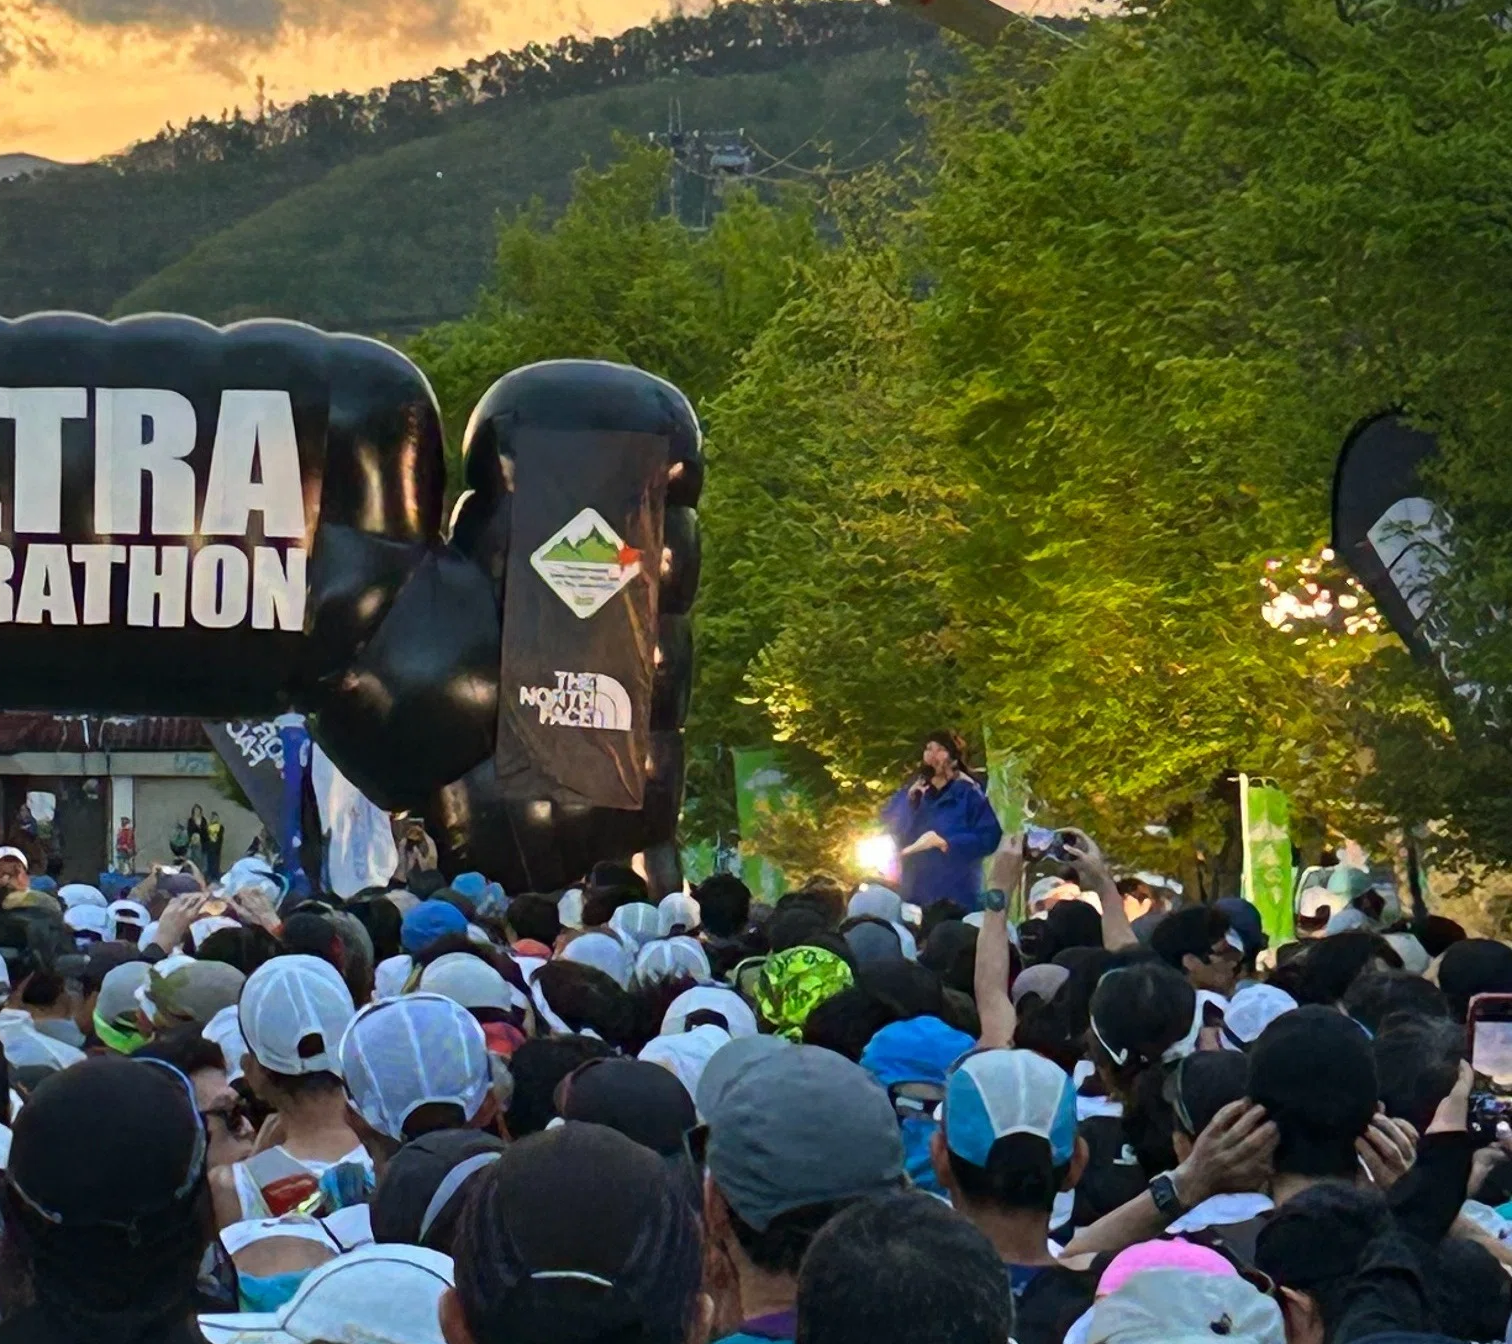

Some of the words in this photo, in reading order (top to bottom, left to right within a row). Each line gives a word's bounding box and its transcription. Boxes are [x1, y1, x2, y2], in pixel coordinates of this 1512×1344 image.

[554, 670, 596, 690] THE
[519, 686, 595, 708] NORTH
[539, 705, 596, 728] FACE
